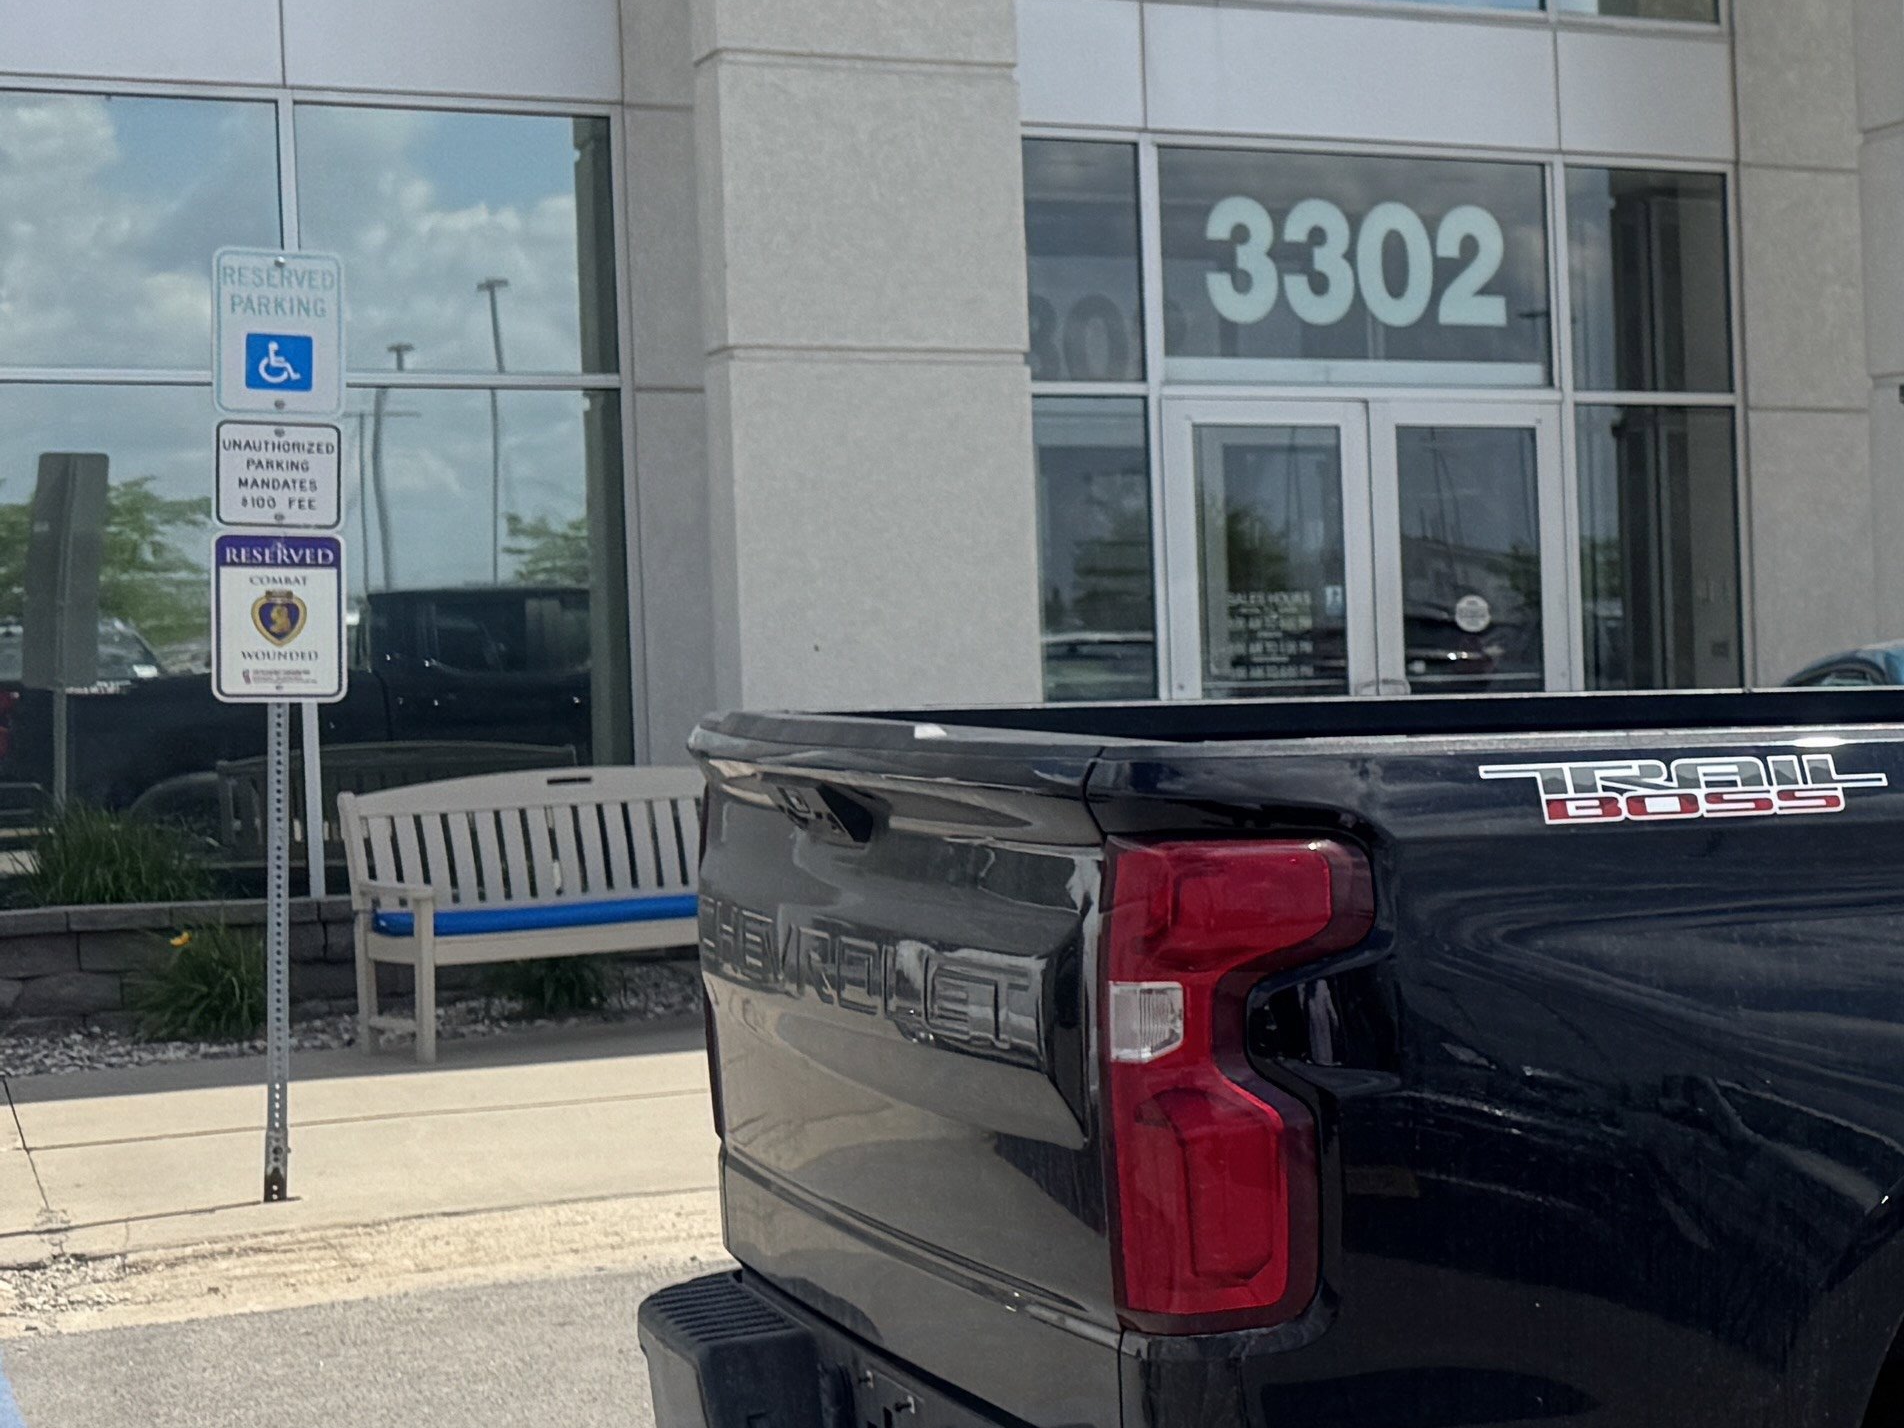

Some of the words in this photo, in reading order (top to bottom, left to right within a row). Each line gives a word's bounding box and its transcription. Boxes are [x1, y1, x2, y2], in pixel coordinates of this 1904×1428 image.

[1206, 196, 1507, 328] 3302
[222, 266, 335, 291] RESERVED
[231, 294, 327, 318] PARKING
[222, 439, 335, 455] UNAUTHORIZED
[246, 458, 310, 473] PARKING
[238, 476, 318, 492] MANDATES
[241, 496, 277, 510] $100
[288, 496, 317, 511] FEE
[225, 546, 335, 565] RESERVED
[249, 575, 307, 586] COMBAT
[241, 651, 319, 662] WOUNDED
[1479, 753, 1888, 797] TRAIL
[1543, 786, 1846, 825] BOSS
